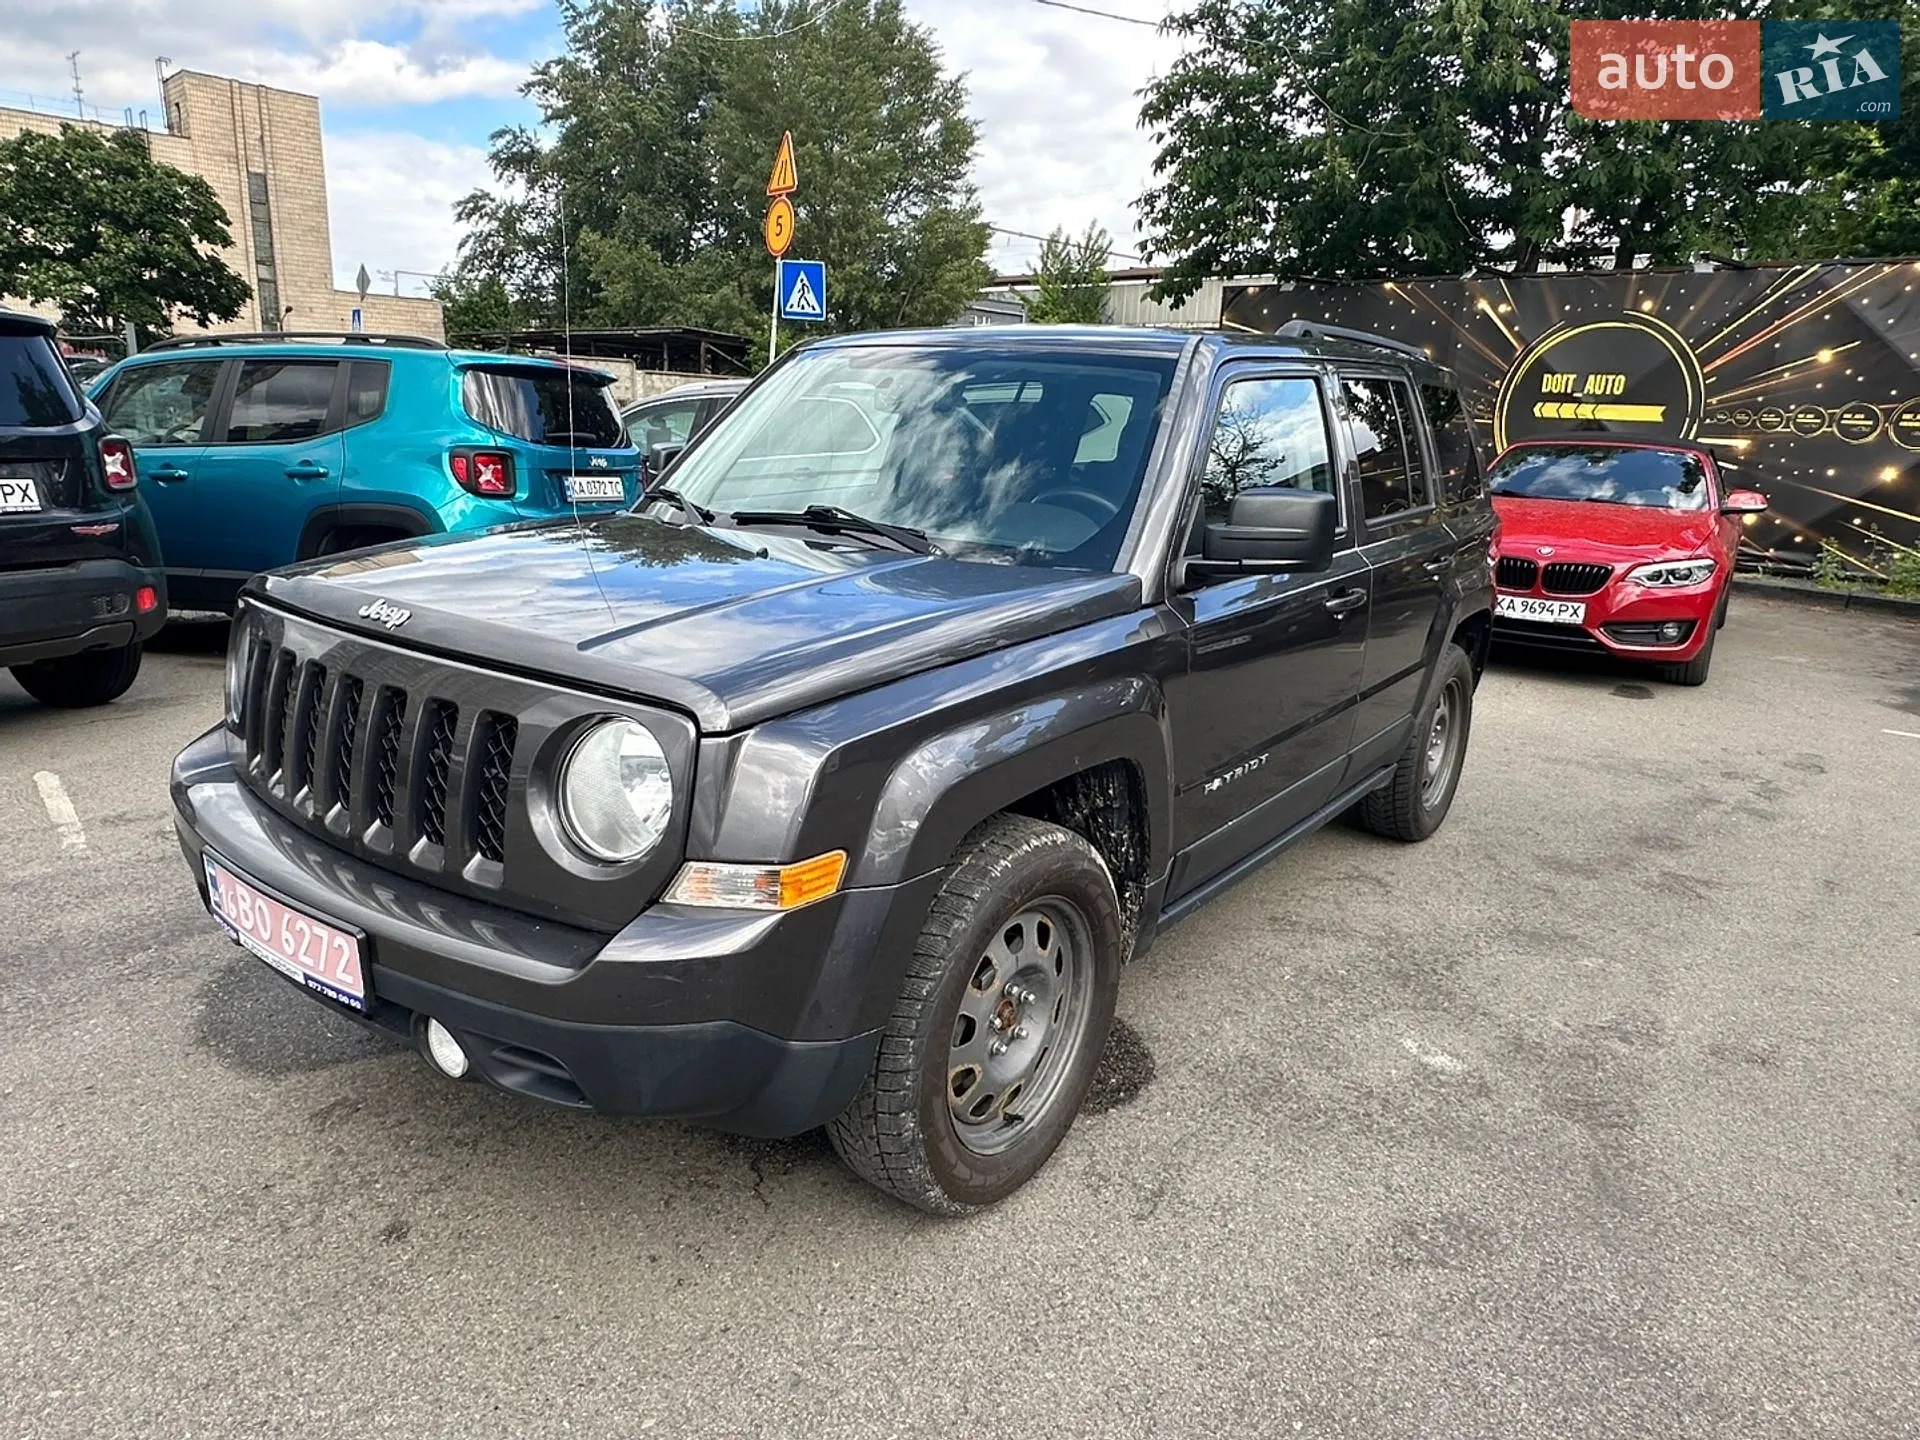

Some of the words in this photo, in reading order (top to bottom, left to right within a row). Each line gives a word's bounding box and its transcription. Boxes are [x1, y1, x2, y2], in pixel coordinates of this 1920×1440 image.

[775, 214, 783, 237] 5
[1541, 373, 1626, 398] DOIT_AUTO
[586, 480, 608, 495] 0372
[608, 481, 621, 495] TC
[358, 598, 412, 630] Jeep
[1496, 598, 1516, 612] KA
[1521, 600, 1555, 616] 9694
[1558, 603, 1581, 618] PX
[1203, 753, 1269, 796] PATRIOT
[281, 912, 354, 984] 6272
